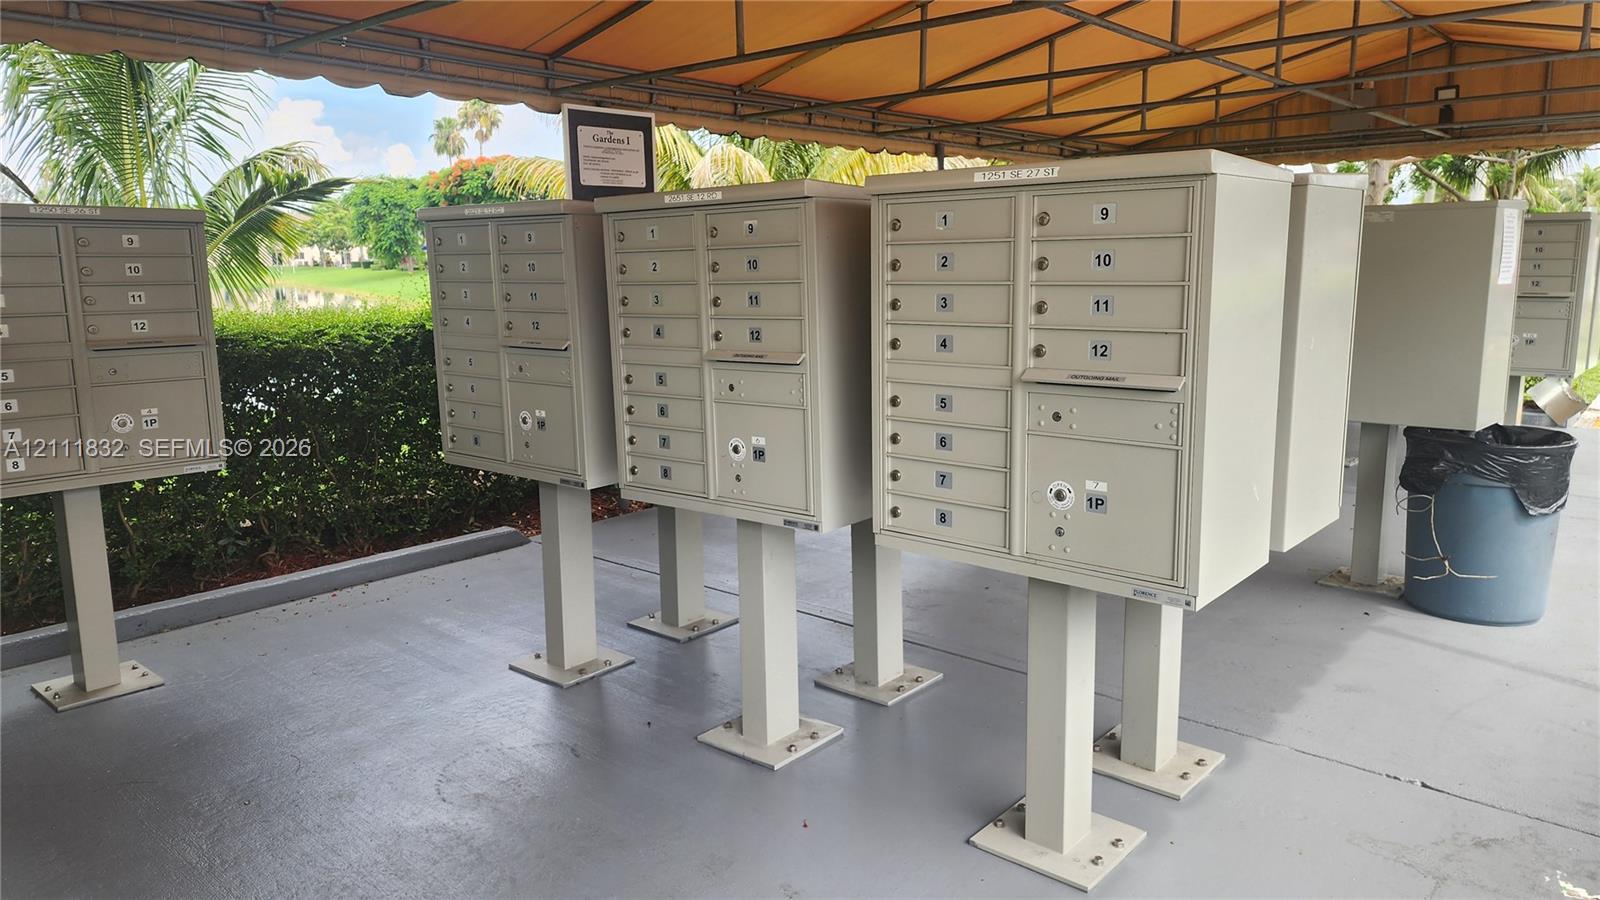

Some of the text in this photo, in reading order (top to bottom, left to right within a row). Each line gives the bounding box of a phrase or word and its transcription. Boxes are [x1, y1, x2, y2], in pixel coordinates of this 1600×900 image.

[592, 133, 625, 145] Gardens
[982, 168, 1056, 180] 1251 SE 27 ST
[1100, 208, 1109, 220] 9
[941, 215, 948, 226] 1
[650, 228, 655, 239] 1
[748, 224, 753, 234] 9
[126, 237, 134, 247] 9
[459, 235, 464, 244] 1
[527, 232, 532, 243] 9
[747, 260, 758, 270] 10
[940, 256, 948, 267] 2
[1094, 254, 1112, 266] 10
[127, 265, 140, 275] 10
[461, 262, 466, 272] 2
[527, 263, 536, 271] 10
[651, 261, 658, 272] 2
[130, 293, 143, 303] 11
[463, 290, 468, 299] 3
[654, 294, 660, 305] 3
[748, 295, 759, 305] 11
[940, 297, 948, 308] 3
[1093, 300, 1109, 312] 11
[132, 321, 147, 331] 12
[465, 317, 470, 326] 4
[531, 322, 540, 330] 12
[655, 327, 661, 337] 4
[749, 330, 761, 340] 12
[939, 339, 948, 349] 4
[1091, 345, 1108, 357] 12
[468, 357, 473, 367] 5
[1, 371, 9, 381] 5
[658, 375, 664, 385] 5
[470, 384, 475, 393] 6
[4, 402, 13, 411] 6
[939, 398, 947, 408] 5
[659, 406, 665, 416] 6
[143, 418, 157, 427] 1P
[536, 421, 546, 429] 1P
[8, 432, 15, 440] 7
[661, 438, 667, 448] 7
[939, 437, 947, 447] 6
[752, 450, 765, 459] 1P
[12, 461, 19, 470] 8
[663, 468, 668, 478] 8
[939, 475, 947, 485] 7
[1087, 497, 1105, 509] 1P
[939, 513, 947, 523] 8
